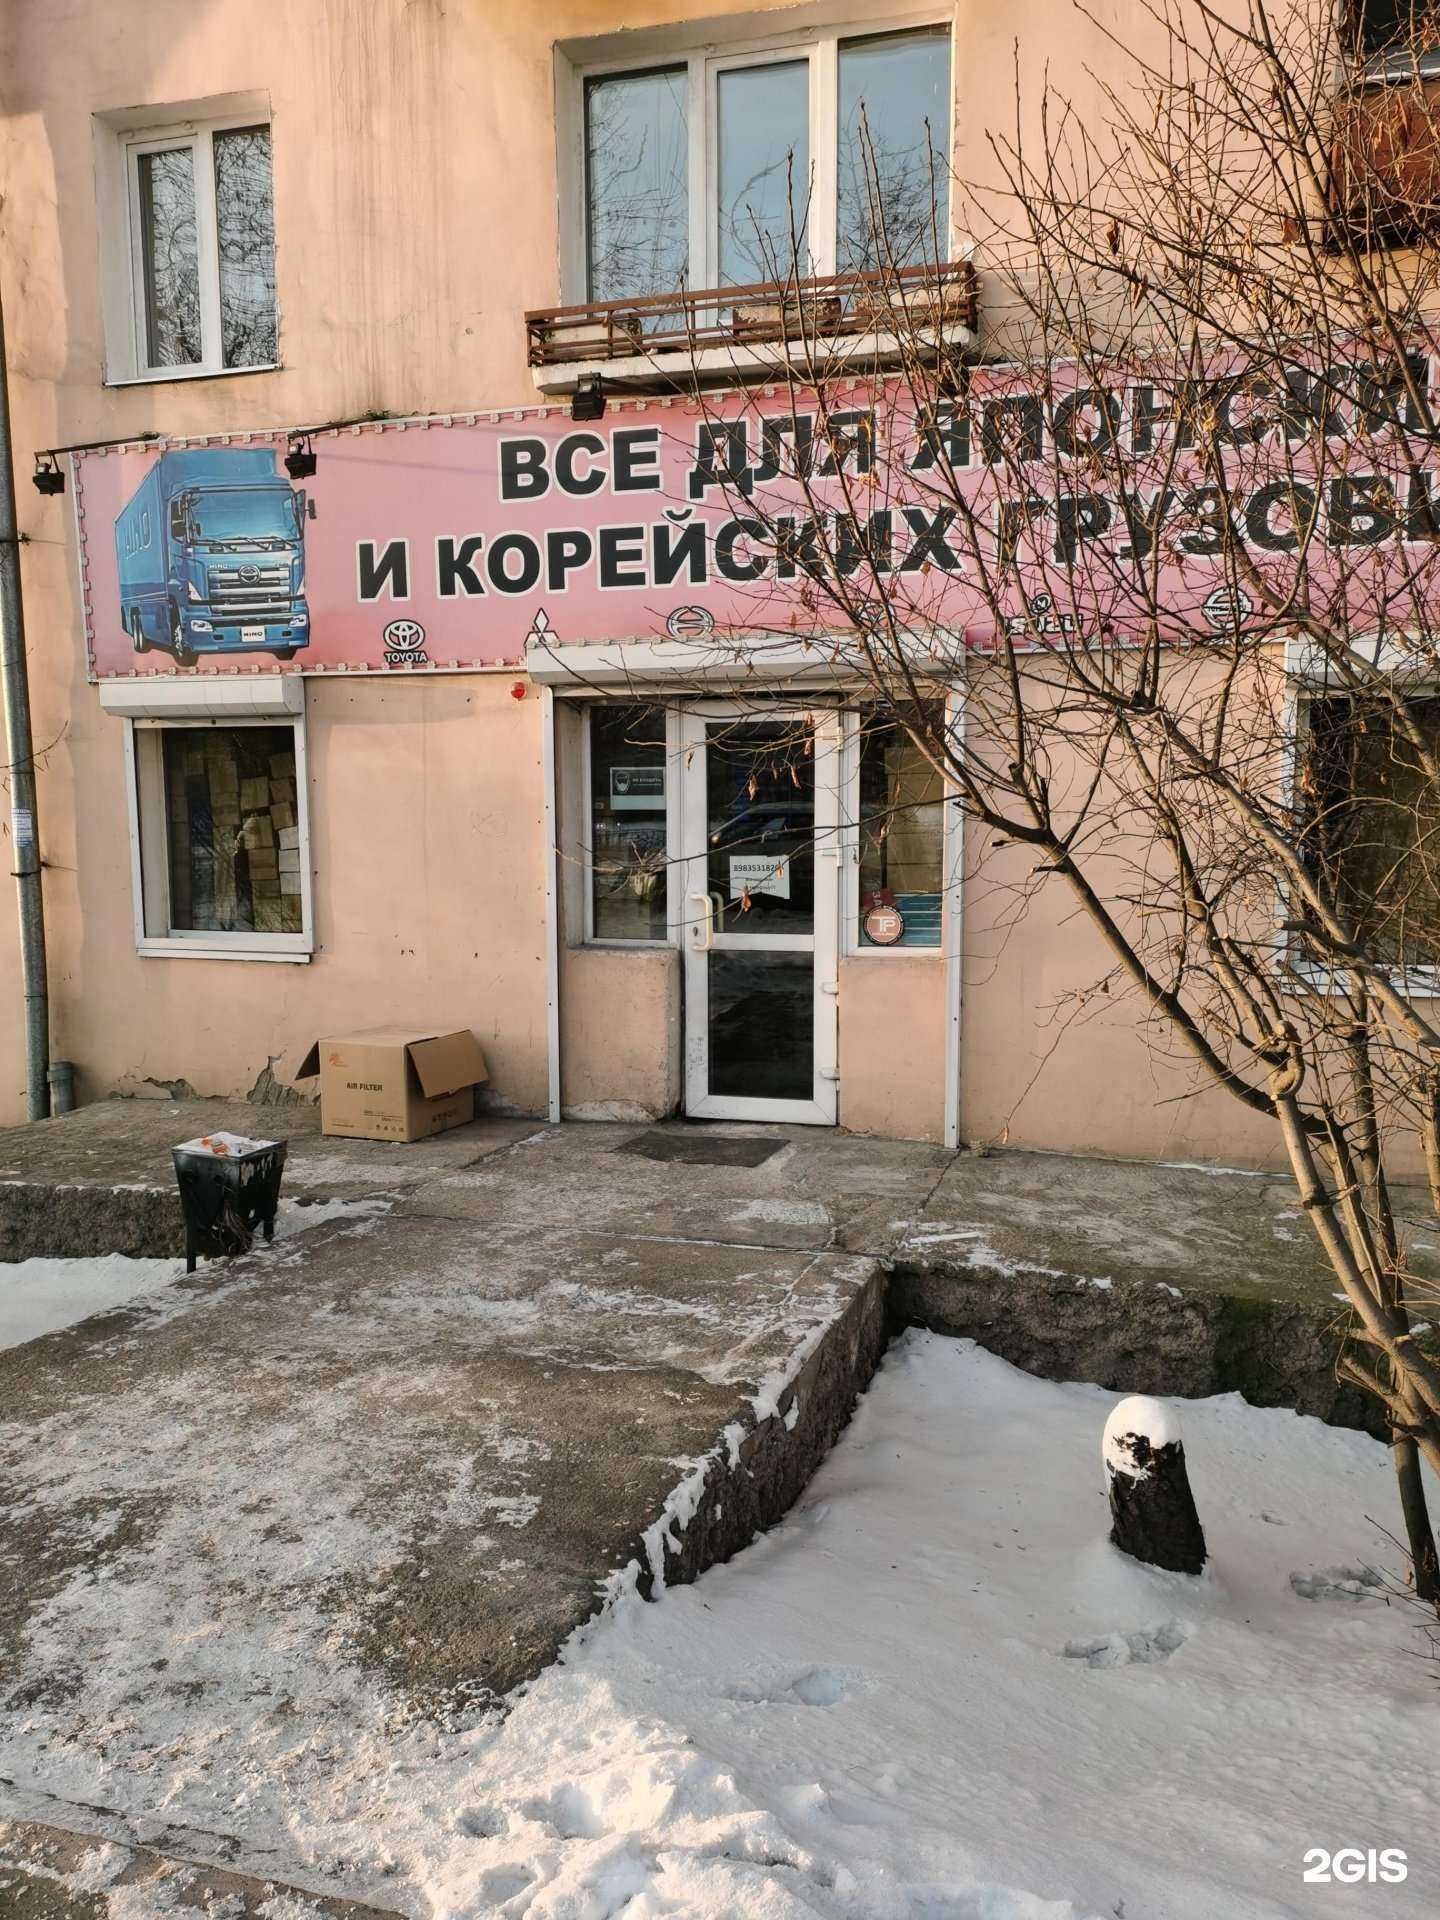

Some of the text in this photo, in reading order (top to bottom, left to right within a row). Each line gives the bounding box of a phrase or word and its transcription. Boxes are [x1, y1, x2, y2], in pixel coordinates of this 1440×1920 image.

[499, 427, 661, 500] ВСЕ
[688, 409, 876, 499] ДЛЯ
[358, 541, 409, 600] И
[437, 508, 963, 597] КОРЕЙСКИХ
[384, 651, 428, 663] TOYOTA
[346, 1082, 383, 1091] AIR FILTER
